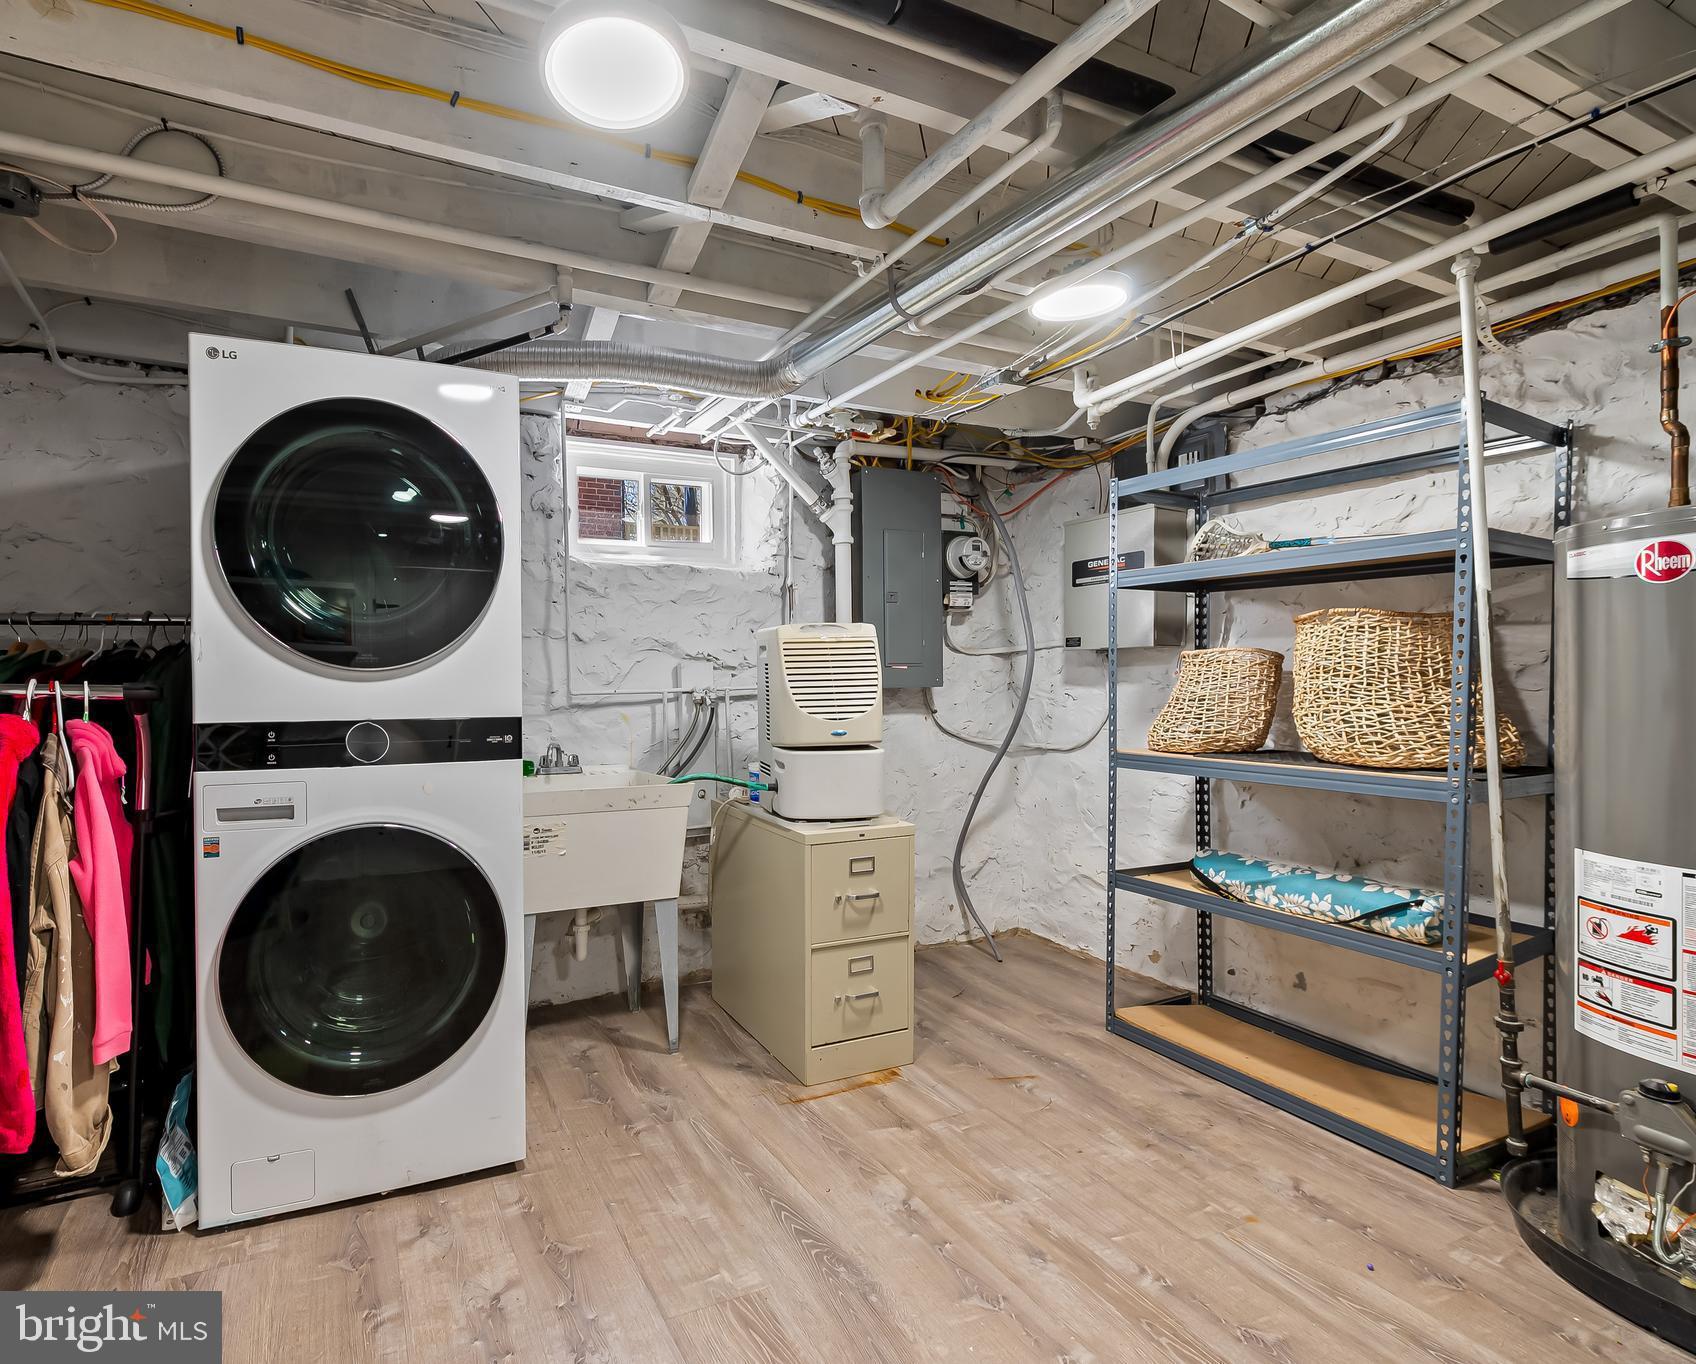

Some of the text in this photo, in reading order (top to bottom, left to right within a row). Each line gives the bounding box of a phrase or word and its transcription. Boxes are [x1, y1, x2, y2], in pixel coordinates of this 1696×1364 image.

[222, 350, 238, 360] LG
[1087, 556, 1126, 569] GENEC
[1641, 541, 1691, 577] Rheem
